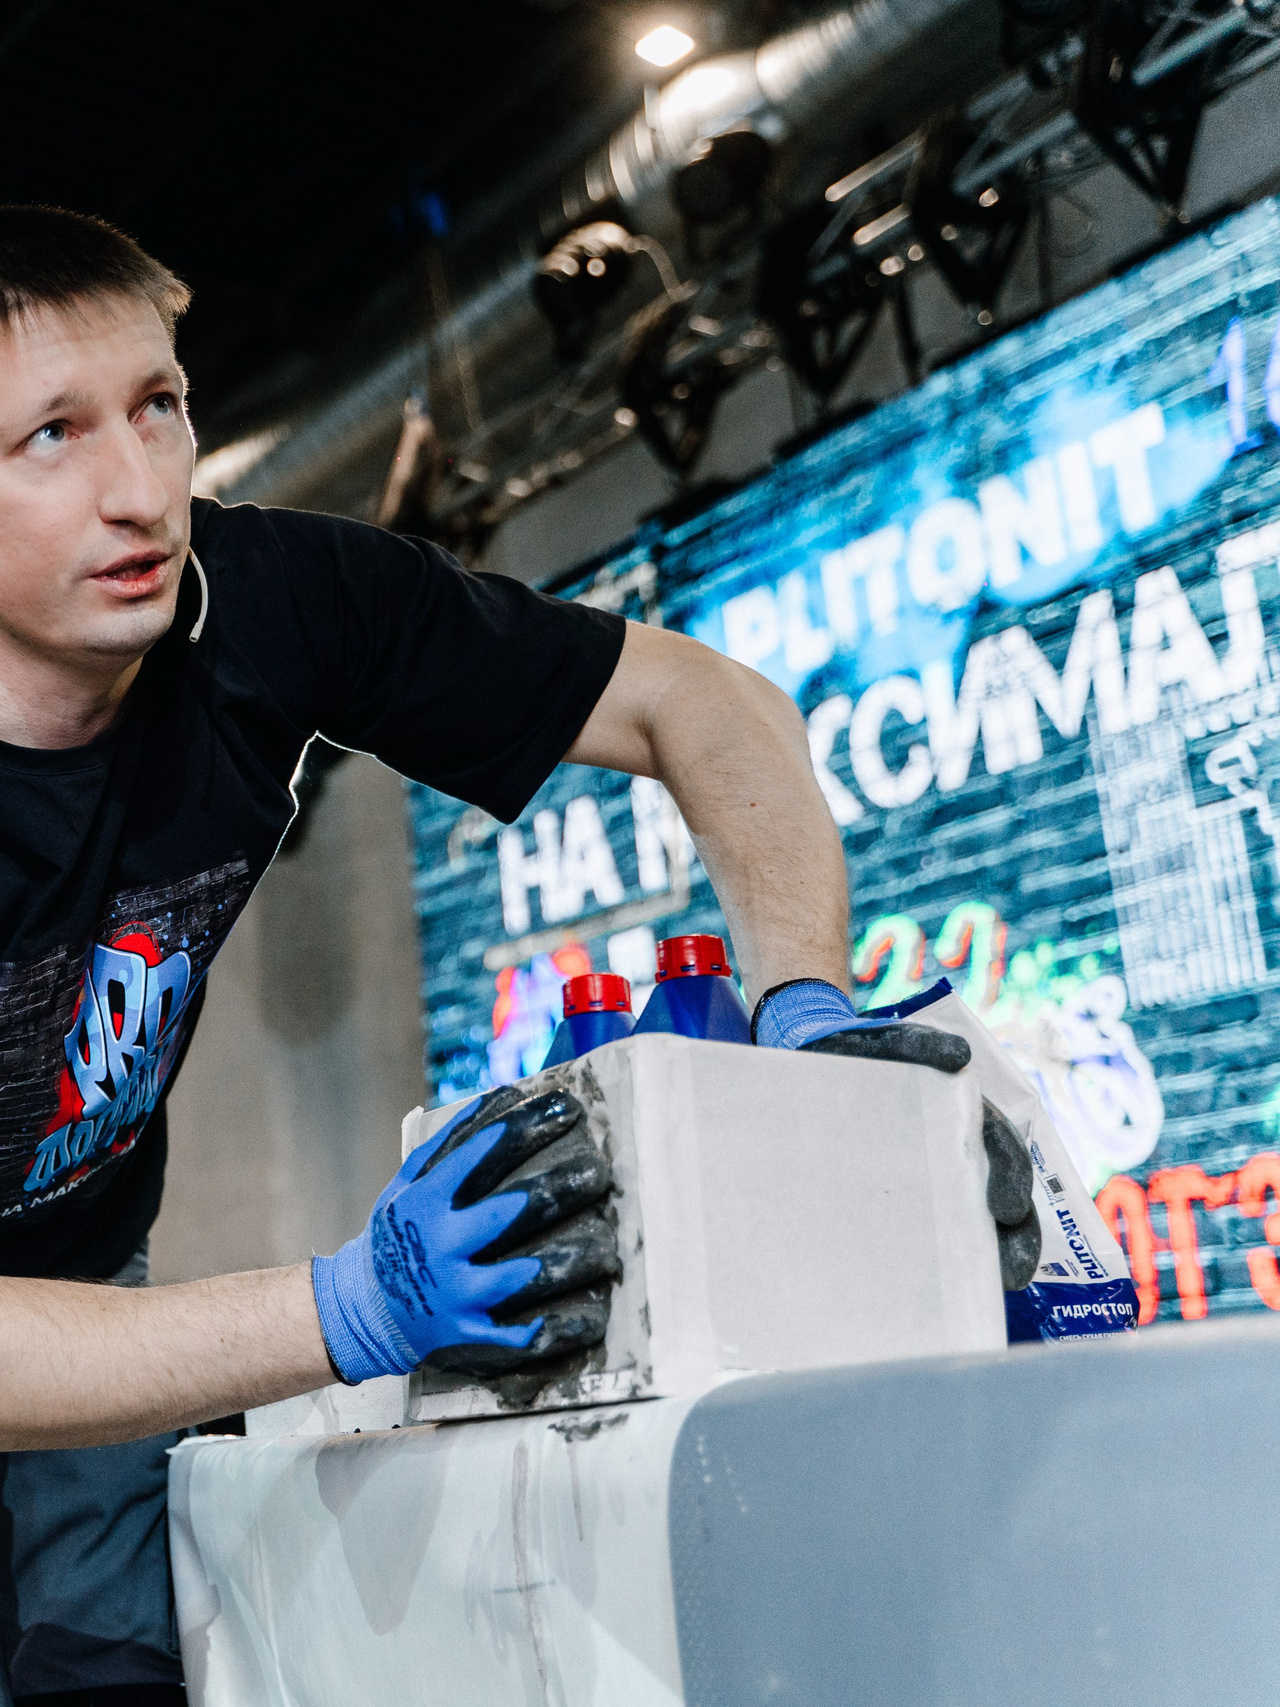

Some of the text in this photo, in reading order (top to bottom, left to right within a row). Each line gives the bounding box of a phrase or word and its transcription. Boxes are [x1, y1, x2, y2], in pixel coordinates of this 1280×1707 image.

[721, 401, 1166, 672] PLITONIT
[497, 795, 625, 936] НА
[1056, 1208, 1105, 1280] PLITONIT
[1052, 1303, 1134, 1319] ГИДРОСТОП
